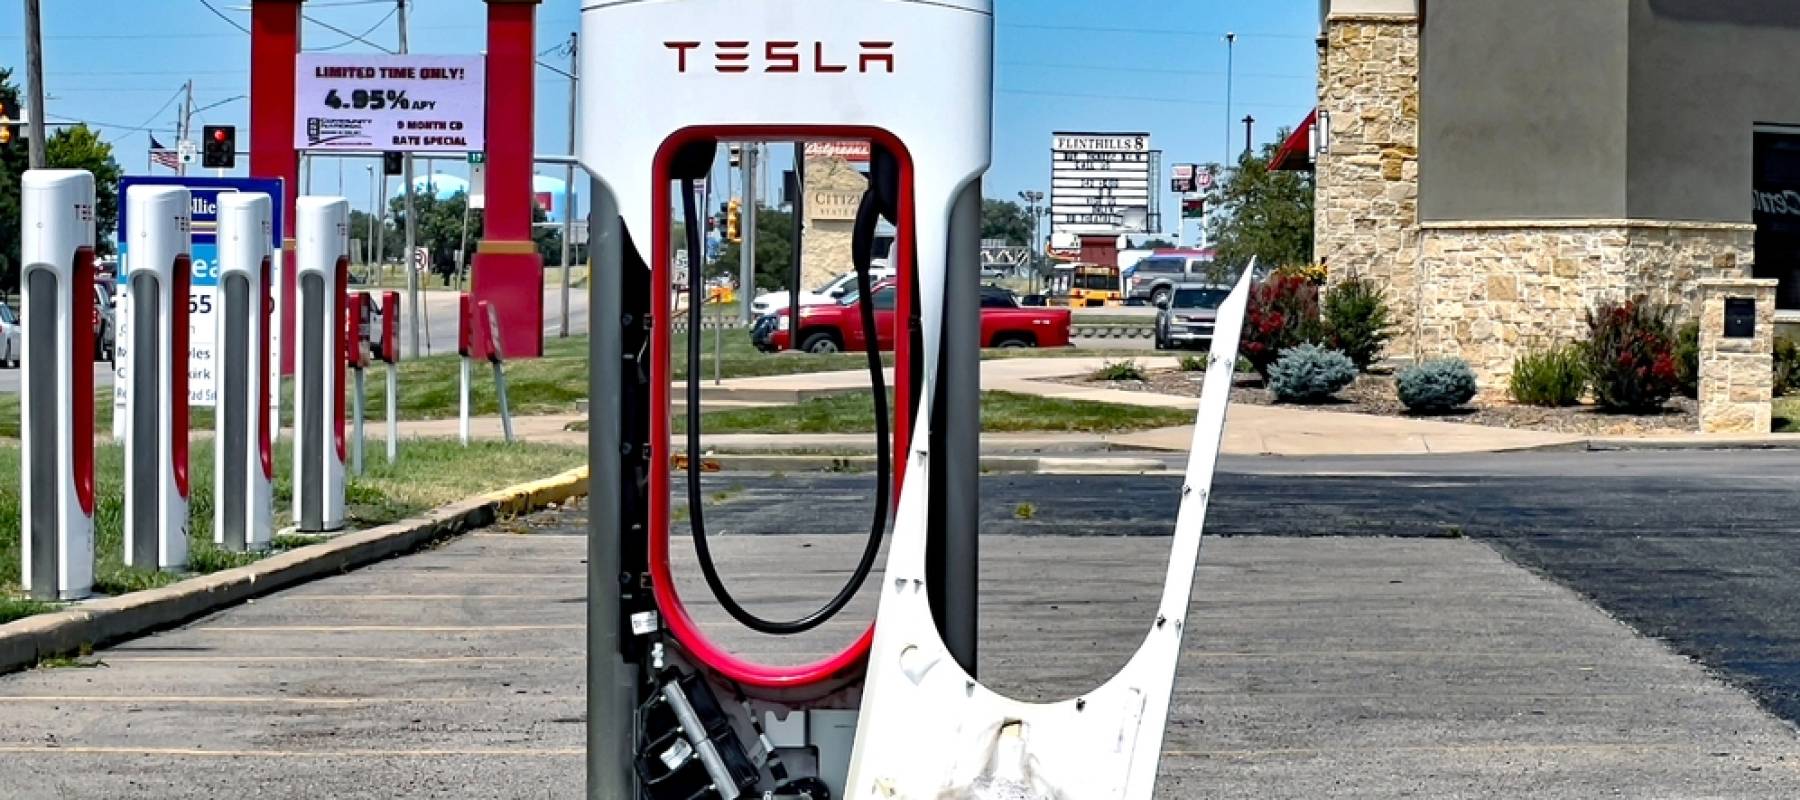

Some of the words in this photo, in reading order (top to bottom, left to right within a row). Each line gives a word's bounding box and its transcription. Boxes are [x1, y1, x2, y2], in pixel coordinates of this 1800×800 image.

[663, 41, 894, 73] TESLA
[316, 66, 375, 79] LIMITED
[380, 67, 416, 79] TIME
[420, 67, 465, 80] ONLY!
[412, 101, 436, 110] APY
[407, 121, 447, 130] MONTH
[449, 121, 463, 130] CD
[392, 135, 420, 146] RATE
[423, 136, 467, 146] SPECIAL
[1058, 138, 1131, 149] FLINTHILLS
[1135, 135, 1144, 150] 8
[815, 192, 861, 205] CITIZ
